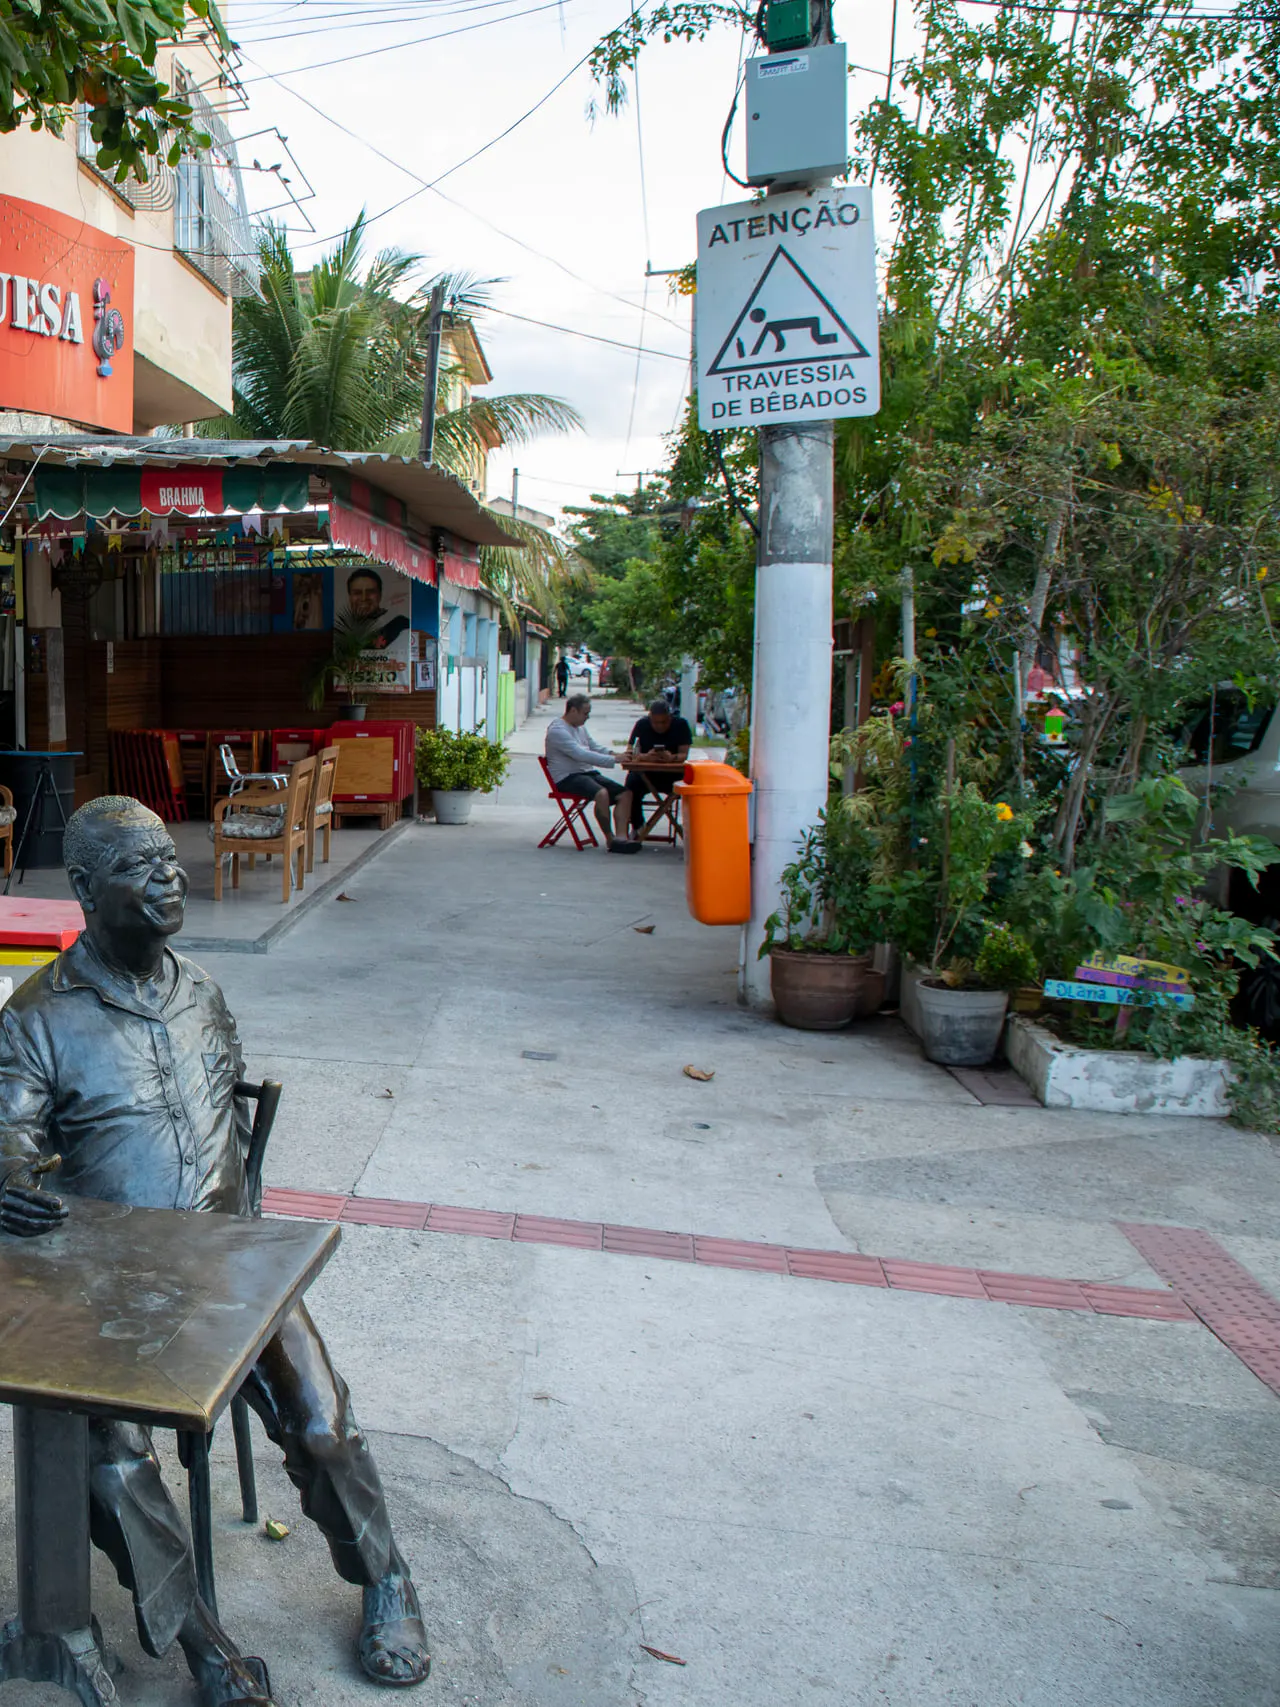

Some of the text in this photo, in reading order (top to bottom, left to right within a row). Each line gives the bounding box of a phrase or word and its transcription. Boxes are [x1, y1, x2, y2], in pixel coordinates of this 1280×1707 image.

[708, 200, 860, 248] ATENÇÃO
[721, 363, 855, 393] TRAVESSIA
[712, 387, 867, 419] DE BÊBADOS
[159, 487, 205, 506] BRAHMA
